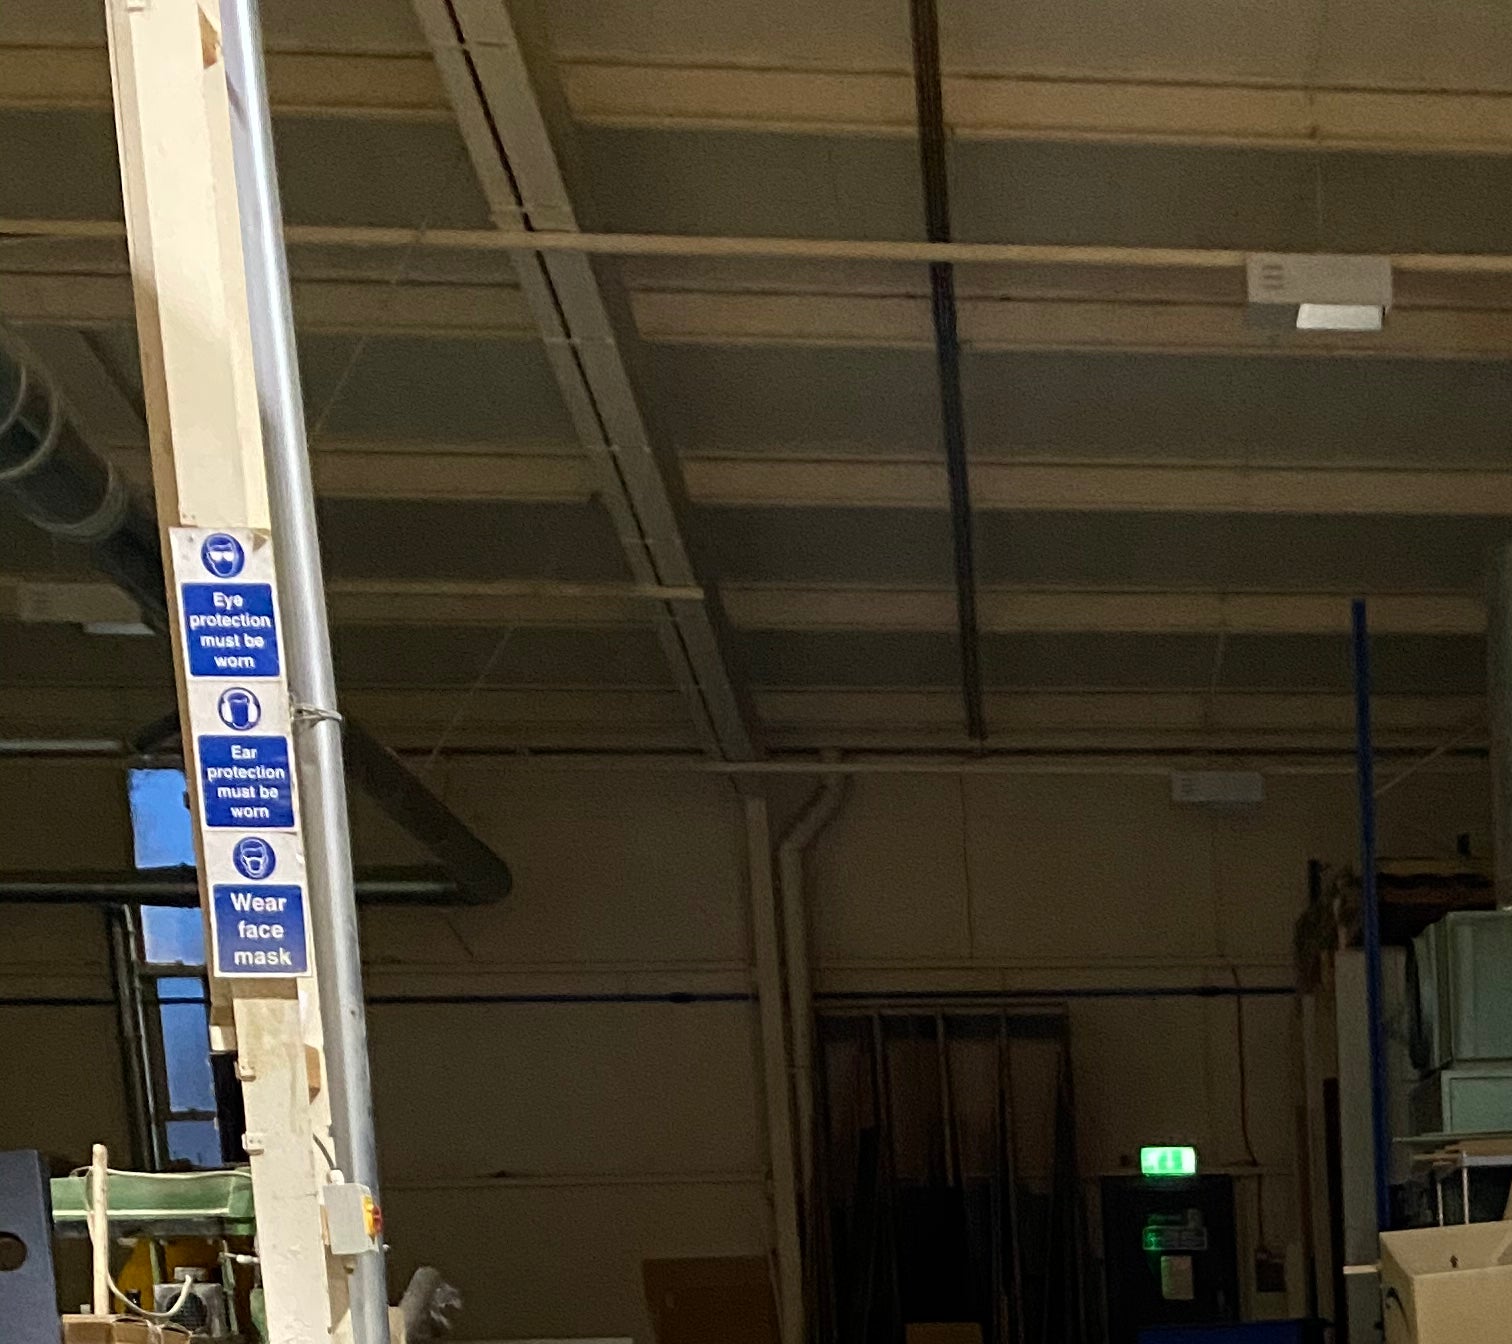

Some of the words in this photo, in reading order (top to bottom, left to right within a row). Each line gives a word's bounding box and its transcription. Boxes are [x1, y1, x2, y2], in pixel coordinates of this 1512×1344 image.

[212, 592, 243, 610] Eye
[189, 613, 272, 630] protection
[200, 634, 240, 647] must
[244, 633, 265, 648] be
[214, 655, 256, 668] worn
[231, 745, 258, 760] Ear
[207, 765, 285, 782] protection
[217, 786, 256, 799] must
[259, 785, 279, 799] be
[230, 805, 270, 819] worn
[230, 893, 287, 912] Wear
[238, 920, 284, 939] face
[234, 947, 292, 966] mask
